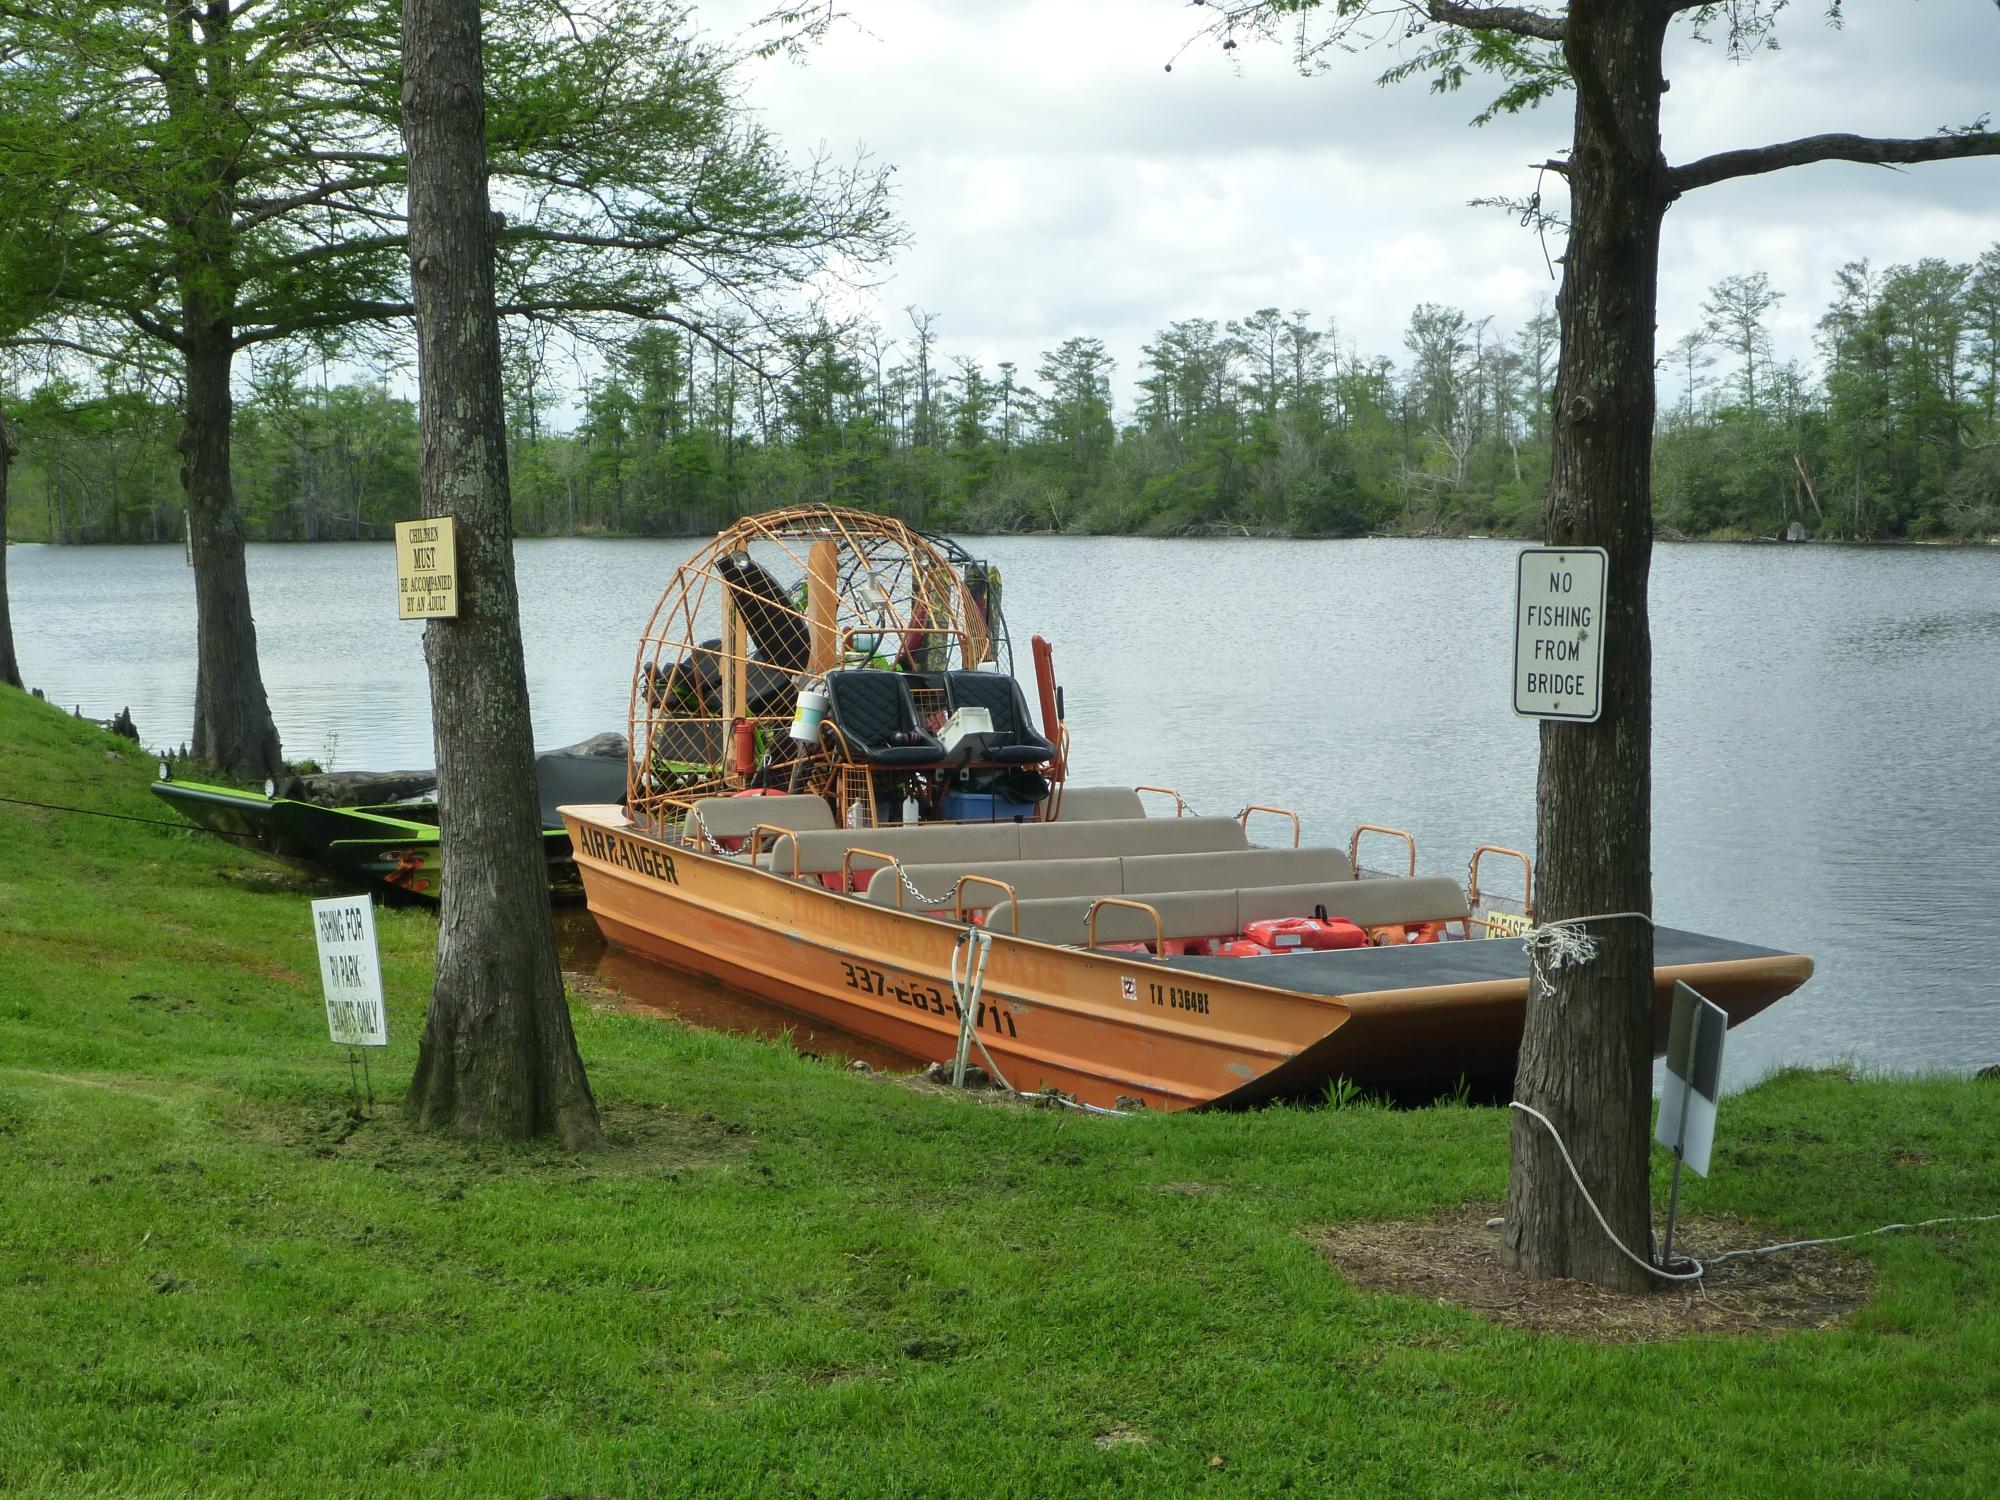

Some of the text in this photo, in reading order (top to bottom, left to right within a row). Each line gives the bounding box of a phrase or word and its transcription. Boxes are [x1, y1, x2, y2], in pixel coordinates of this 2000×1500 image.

[409, 526, 438, 544] CHILDREN
[413, 547, 436, 569] MUST
[401, 575, 452, 593] BE ACCOMPANIED
[1550, 572, 1572, 593] NO
[407, 596, 446, 612] BY AN ADULT
[1527, 606, 1591, 627] FISHING
[1535, 640, 1580, 661] FROM
[1527, 673, 1585, 695] BRIDGE
[319, 908, 364, 942] FISHING FOR
[330, 955, 361, 987] RV PARK
[1150, 984, 1163, 1006] TX
[328, 1000, 378, 1034] TENANTS ONLY
